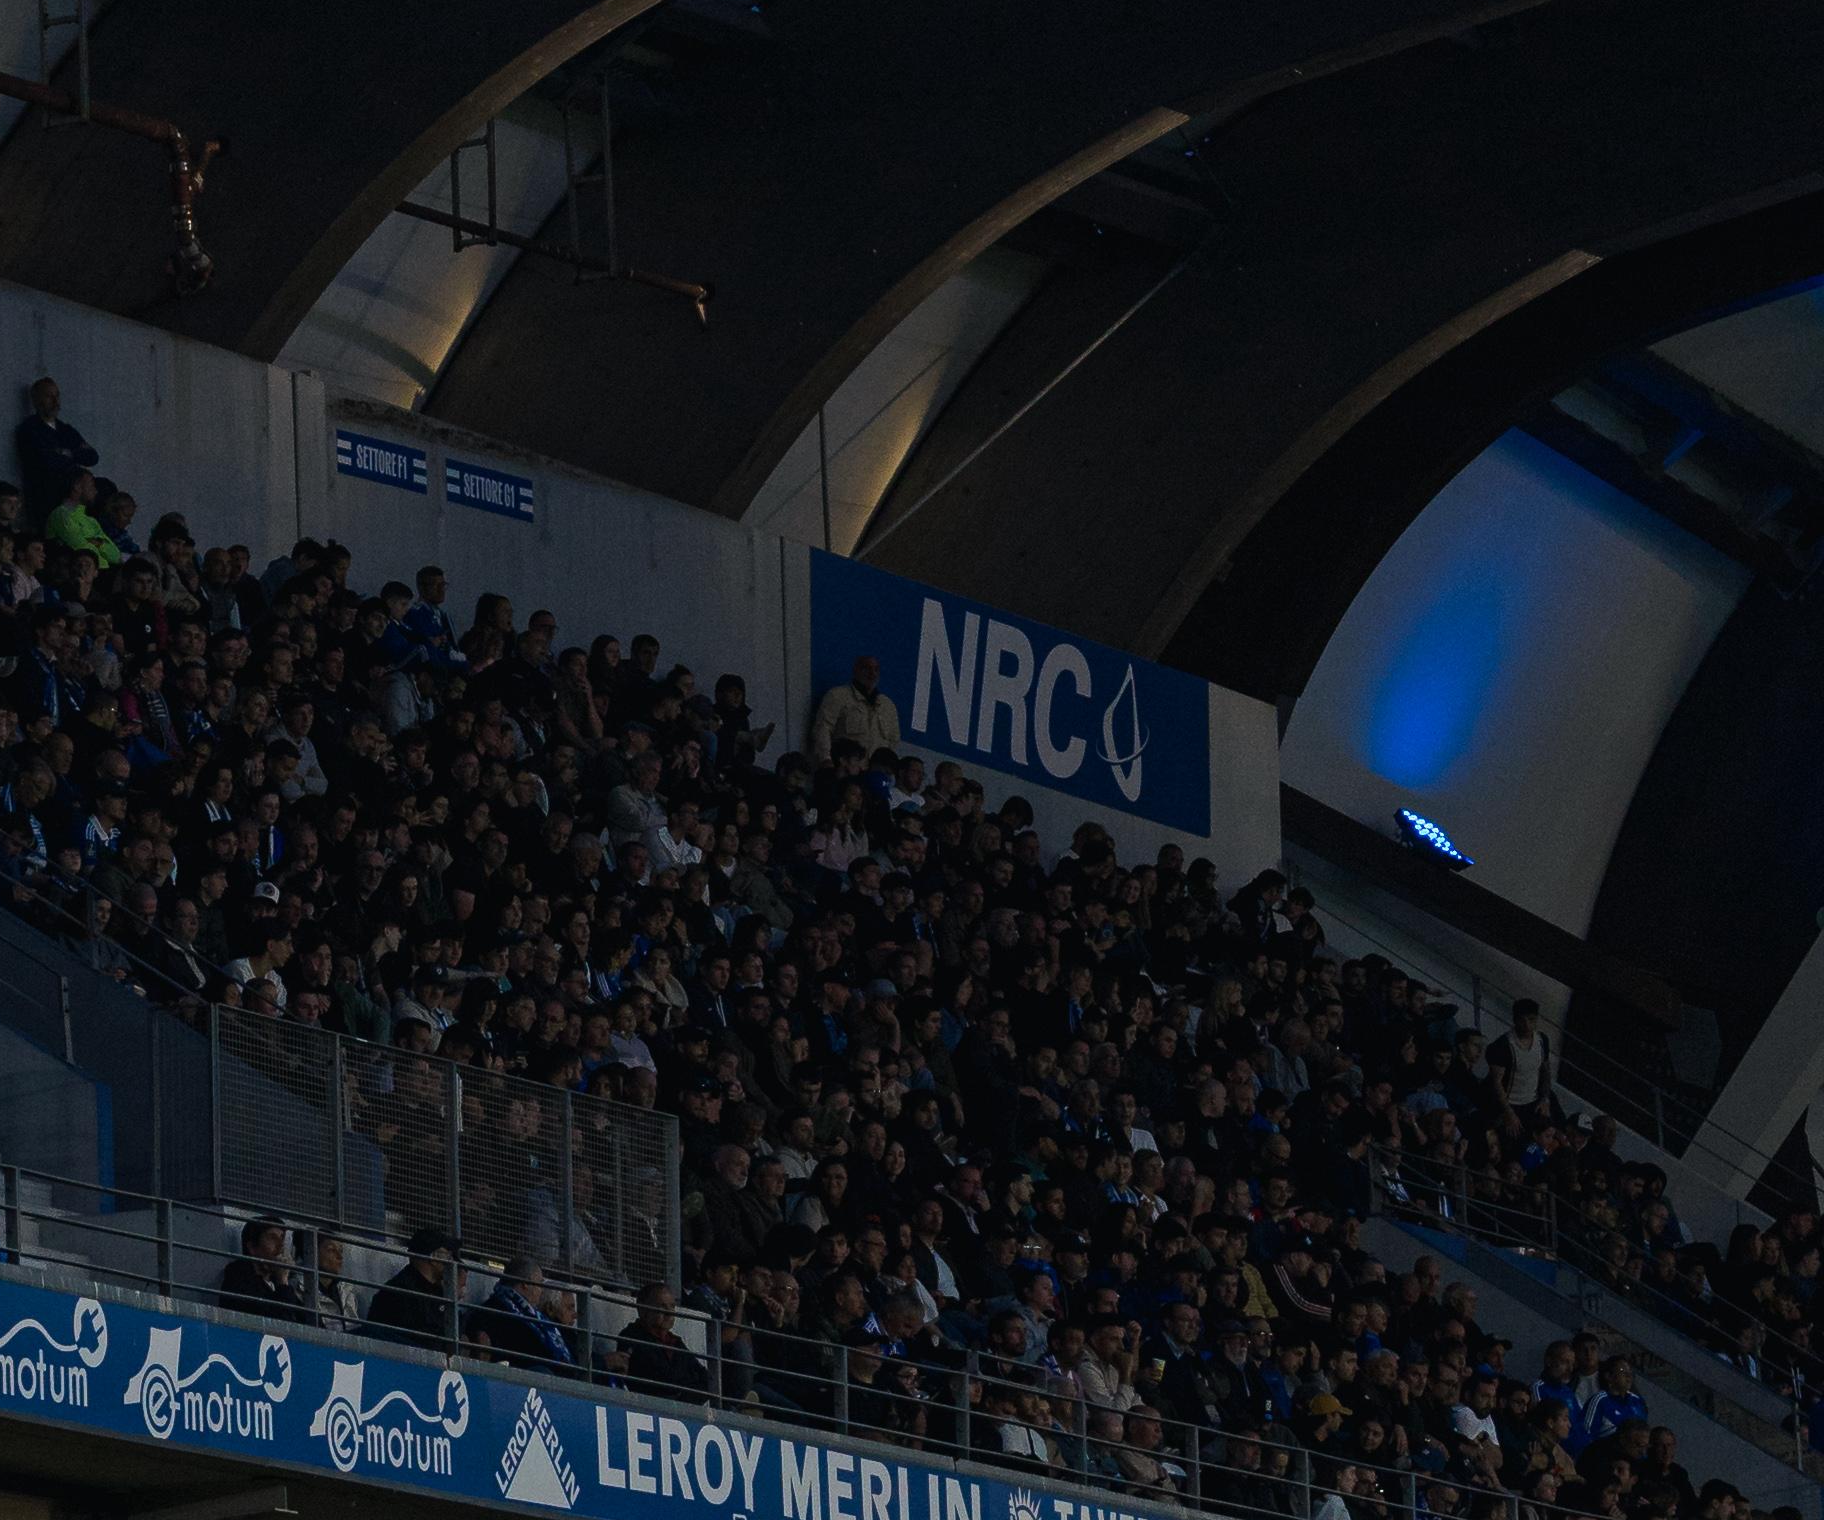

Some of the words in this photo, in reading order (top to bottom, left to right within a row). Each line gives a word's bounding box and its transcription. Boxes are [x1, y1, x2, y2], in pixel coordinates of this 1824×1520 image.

[356, 444, 397, 479] SETTORE
[398, 453, 408, 480] F1
[463, 473, 504, 505] SETTORE
[911, 597, 1092, 780] NRC
[495, 1401, 534, 1494] LEROY
[527, 1387, 580, 1506] MERLIN
[595, 1406, 764, 1512] LEROY
